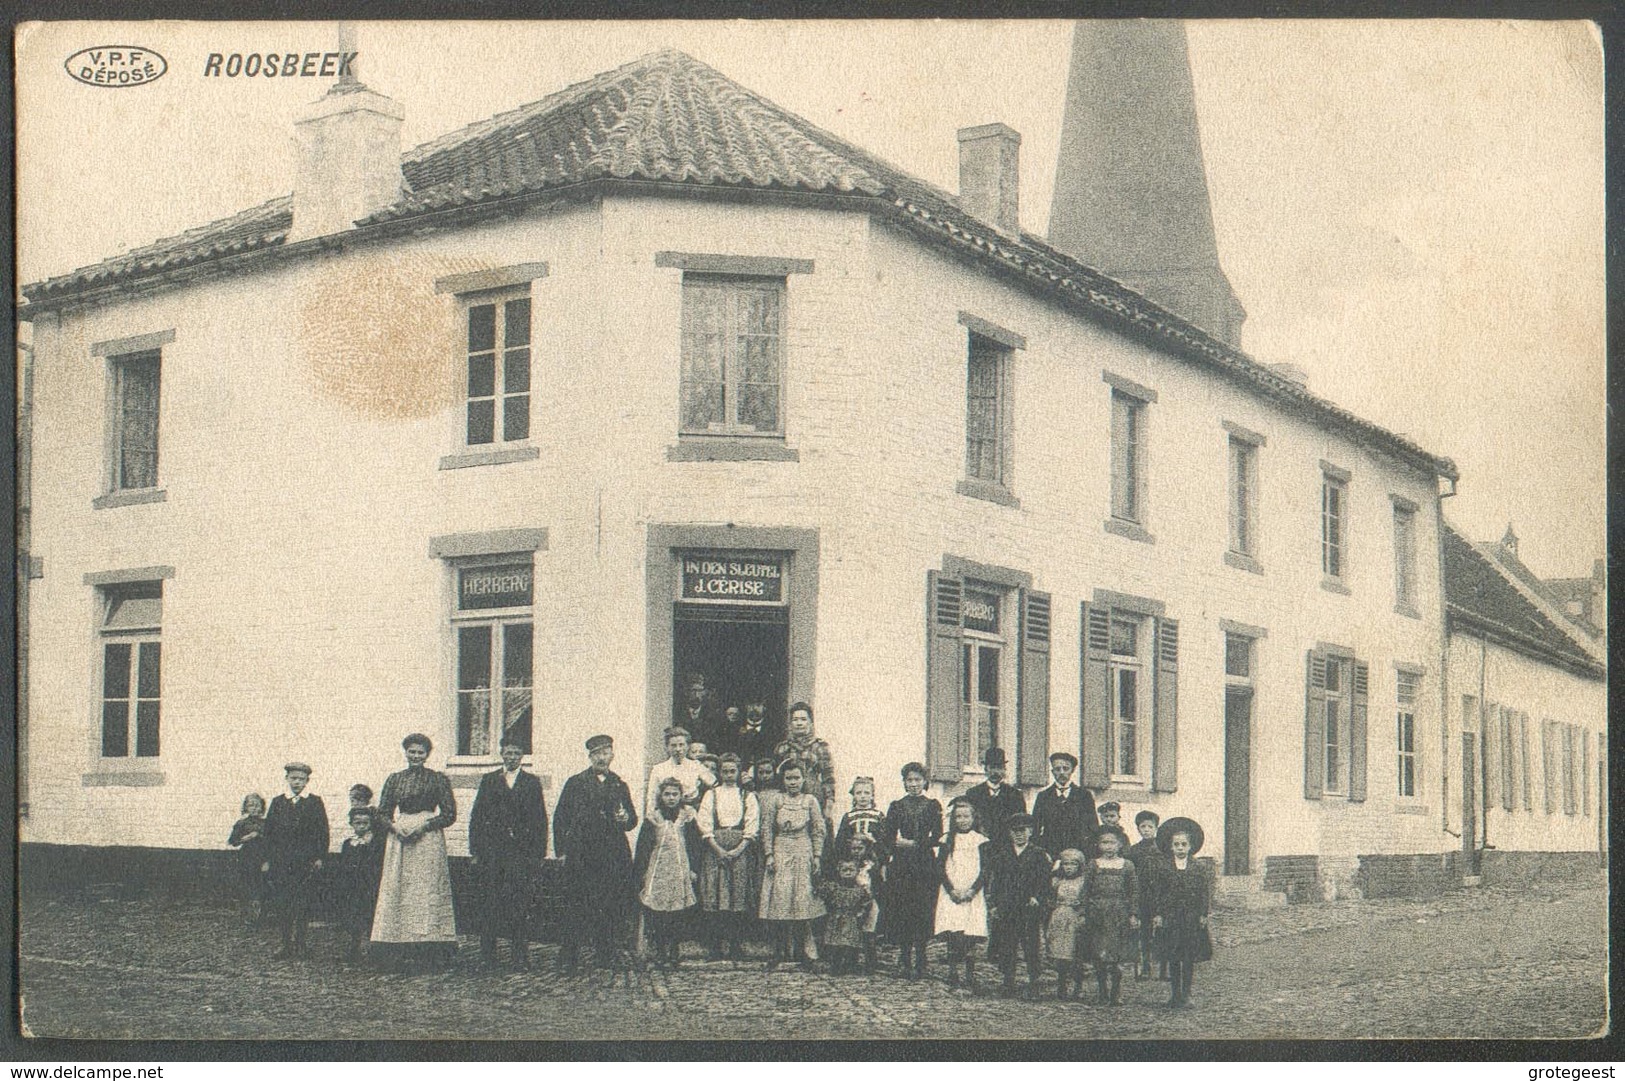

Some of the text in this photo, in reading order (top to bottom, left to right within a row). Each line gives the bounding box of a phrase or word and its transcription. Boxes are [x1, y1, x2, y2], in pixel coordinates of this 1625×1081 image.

[686, 561, 780, 578] IN DEN SLEUTEL
[464, 574, 528, 595] HERBERG
